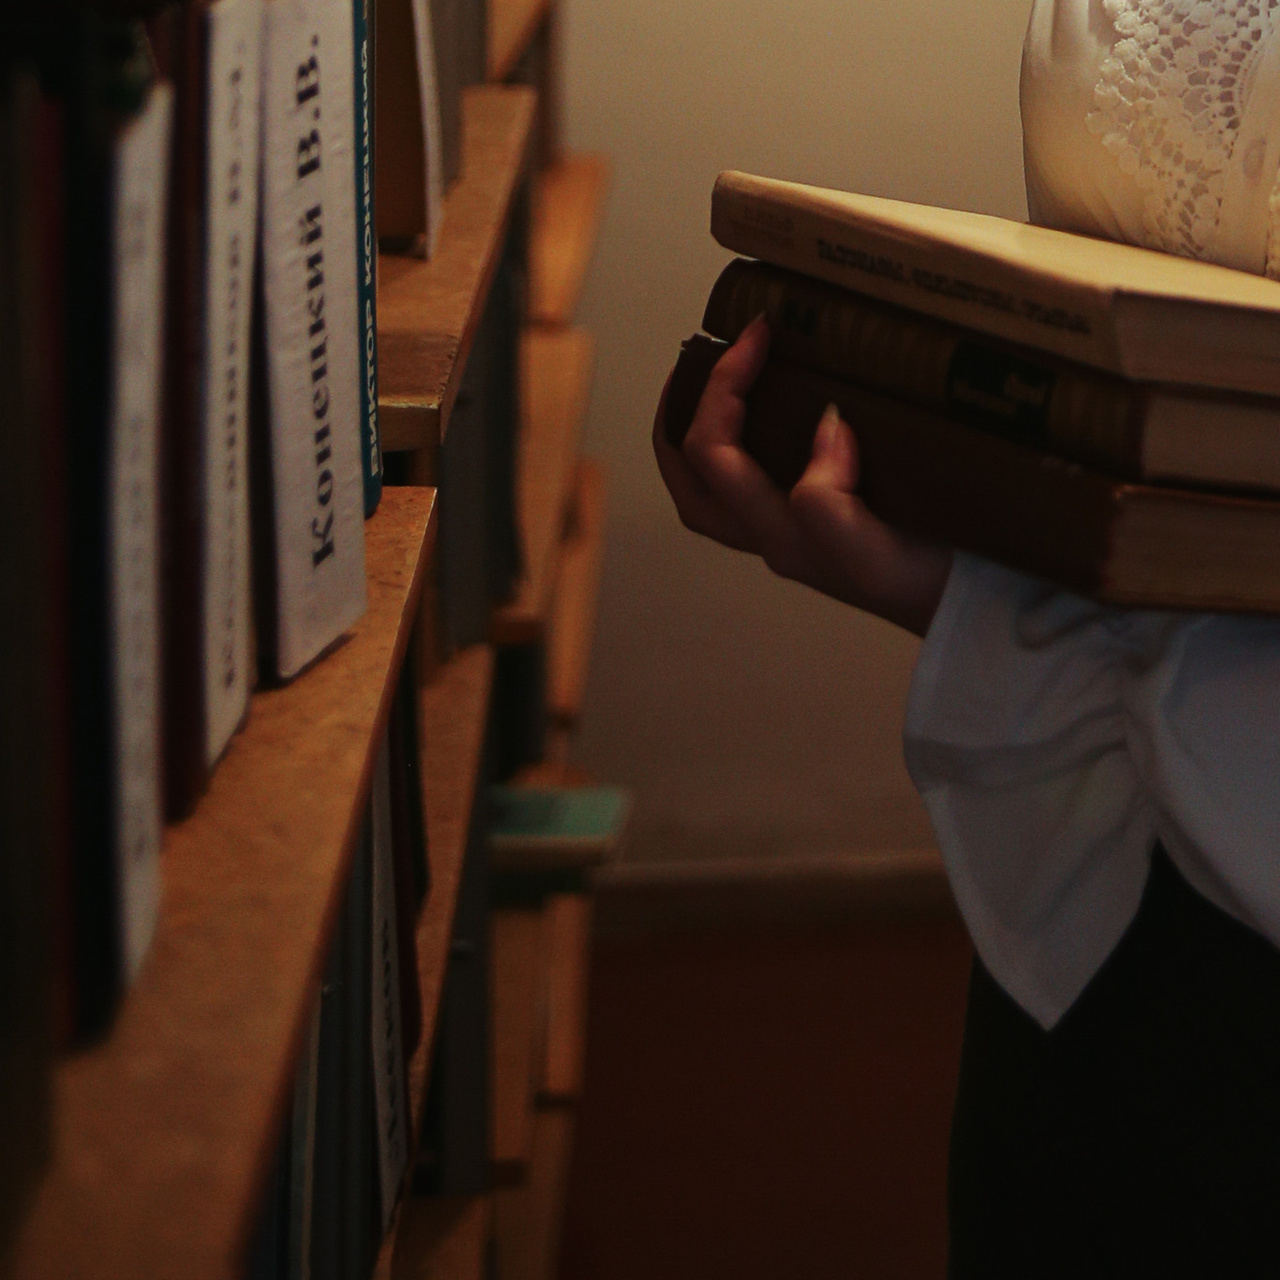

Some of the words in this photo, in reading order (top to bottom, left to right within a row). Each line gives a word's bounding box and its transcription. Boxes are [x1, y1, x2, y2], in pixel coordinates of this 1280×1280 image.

[295, 34, 324, 181] В.В.
[359, 40, 373, 287] КОНЕЦКИЙ
[299, 203, 337, 570] Конецкий
[364, 300, 380, 477] ВИКТОР
